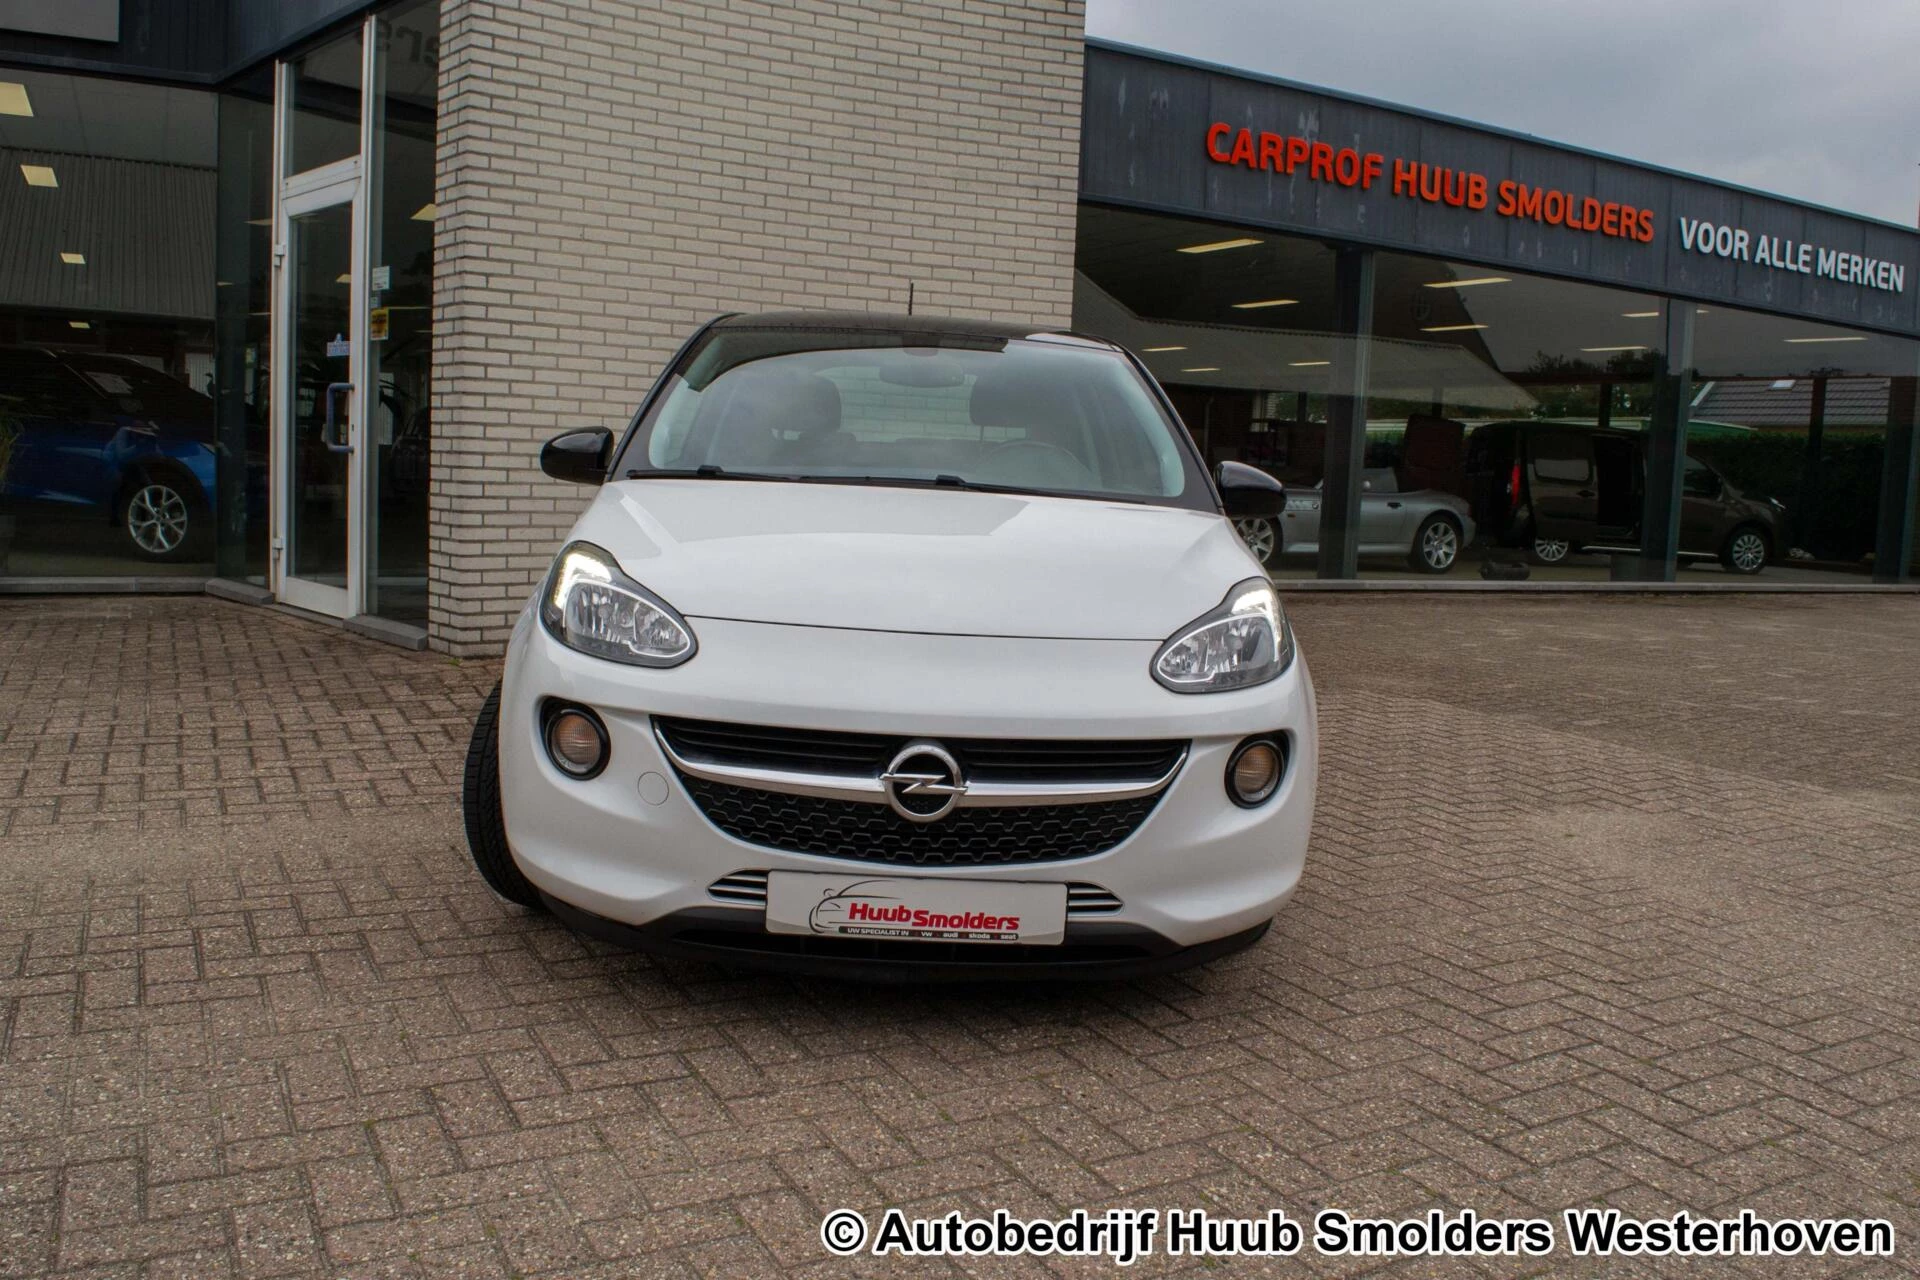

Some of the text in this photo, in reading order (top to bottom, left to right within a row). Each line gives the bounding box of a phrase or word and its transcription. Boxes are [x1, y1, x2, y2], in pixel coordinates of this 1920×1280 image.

[1206, 121, 1655, 243] CARPROF HUUB SMOLDERS
[1680, 216, 1905, 293] VOOR ALLE MERKEN
[847, 927, 861, 935] UW
[860, 927, 900, 937] SPECIALIST
[942, 931, 959, 939] audi
